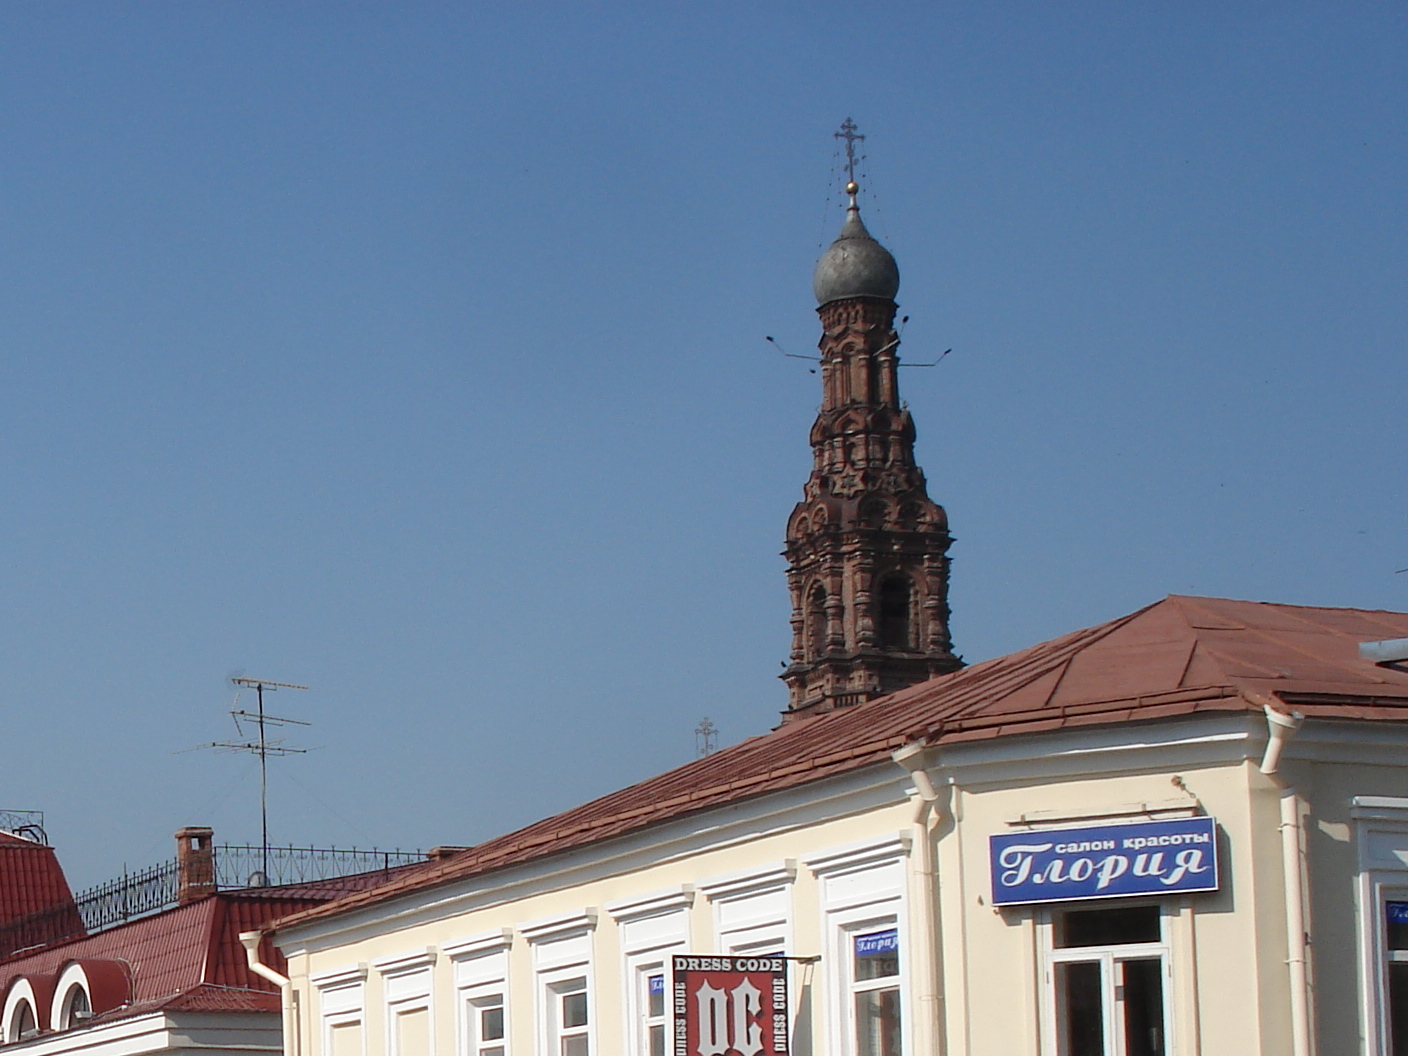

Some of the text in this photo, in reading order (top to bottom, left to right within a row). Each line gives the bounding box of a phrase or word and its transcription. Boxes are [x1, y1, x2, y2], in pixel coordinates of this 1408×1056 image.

[999, 843, 1211, 891] Глория
[1055, 832, 1210, 854] салон красоты
[675, 958, 783, 972] DRESS CODE
[675, 982, 687, 1056] DRESS CODE
[772, 978, 786, 1052] DRESS CODE
